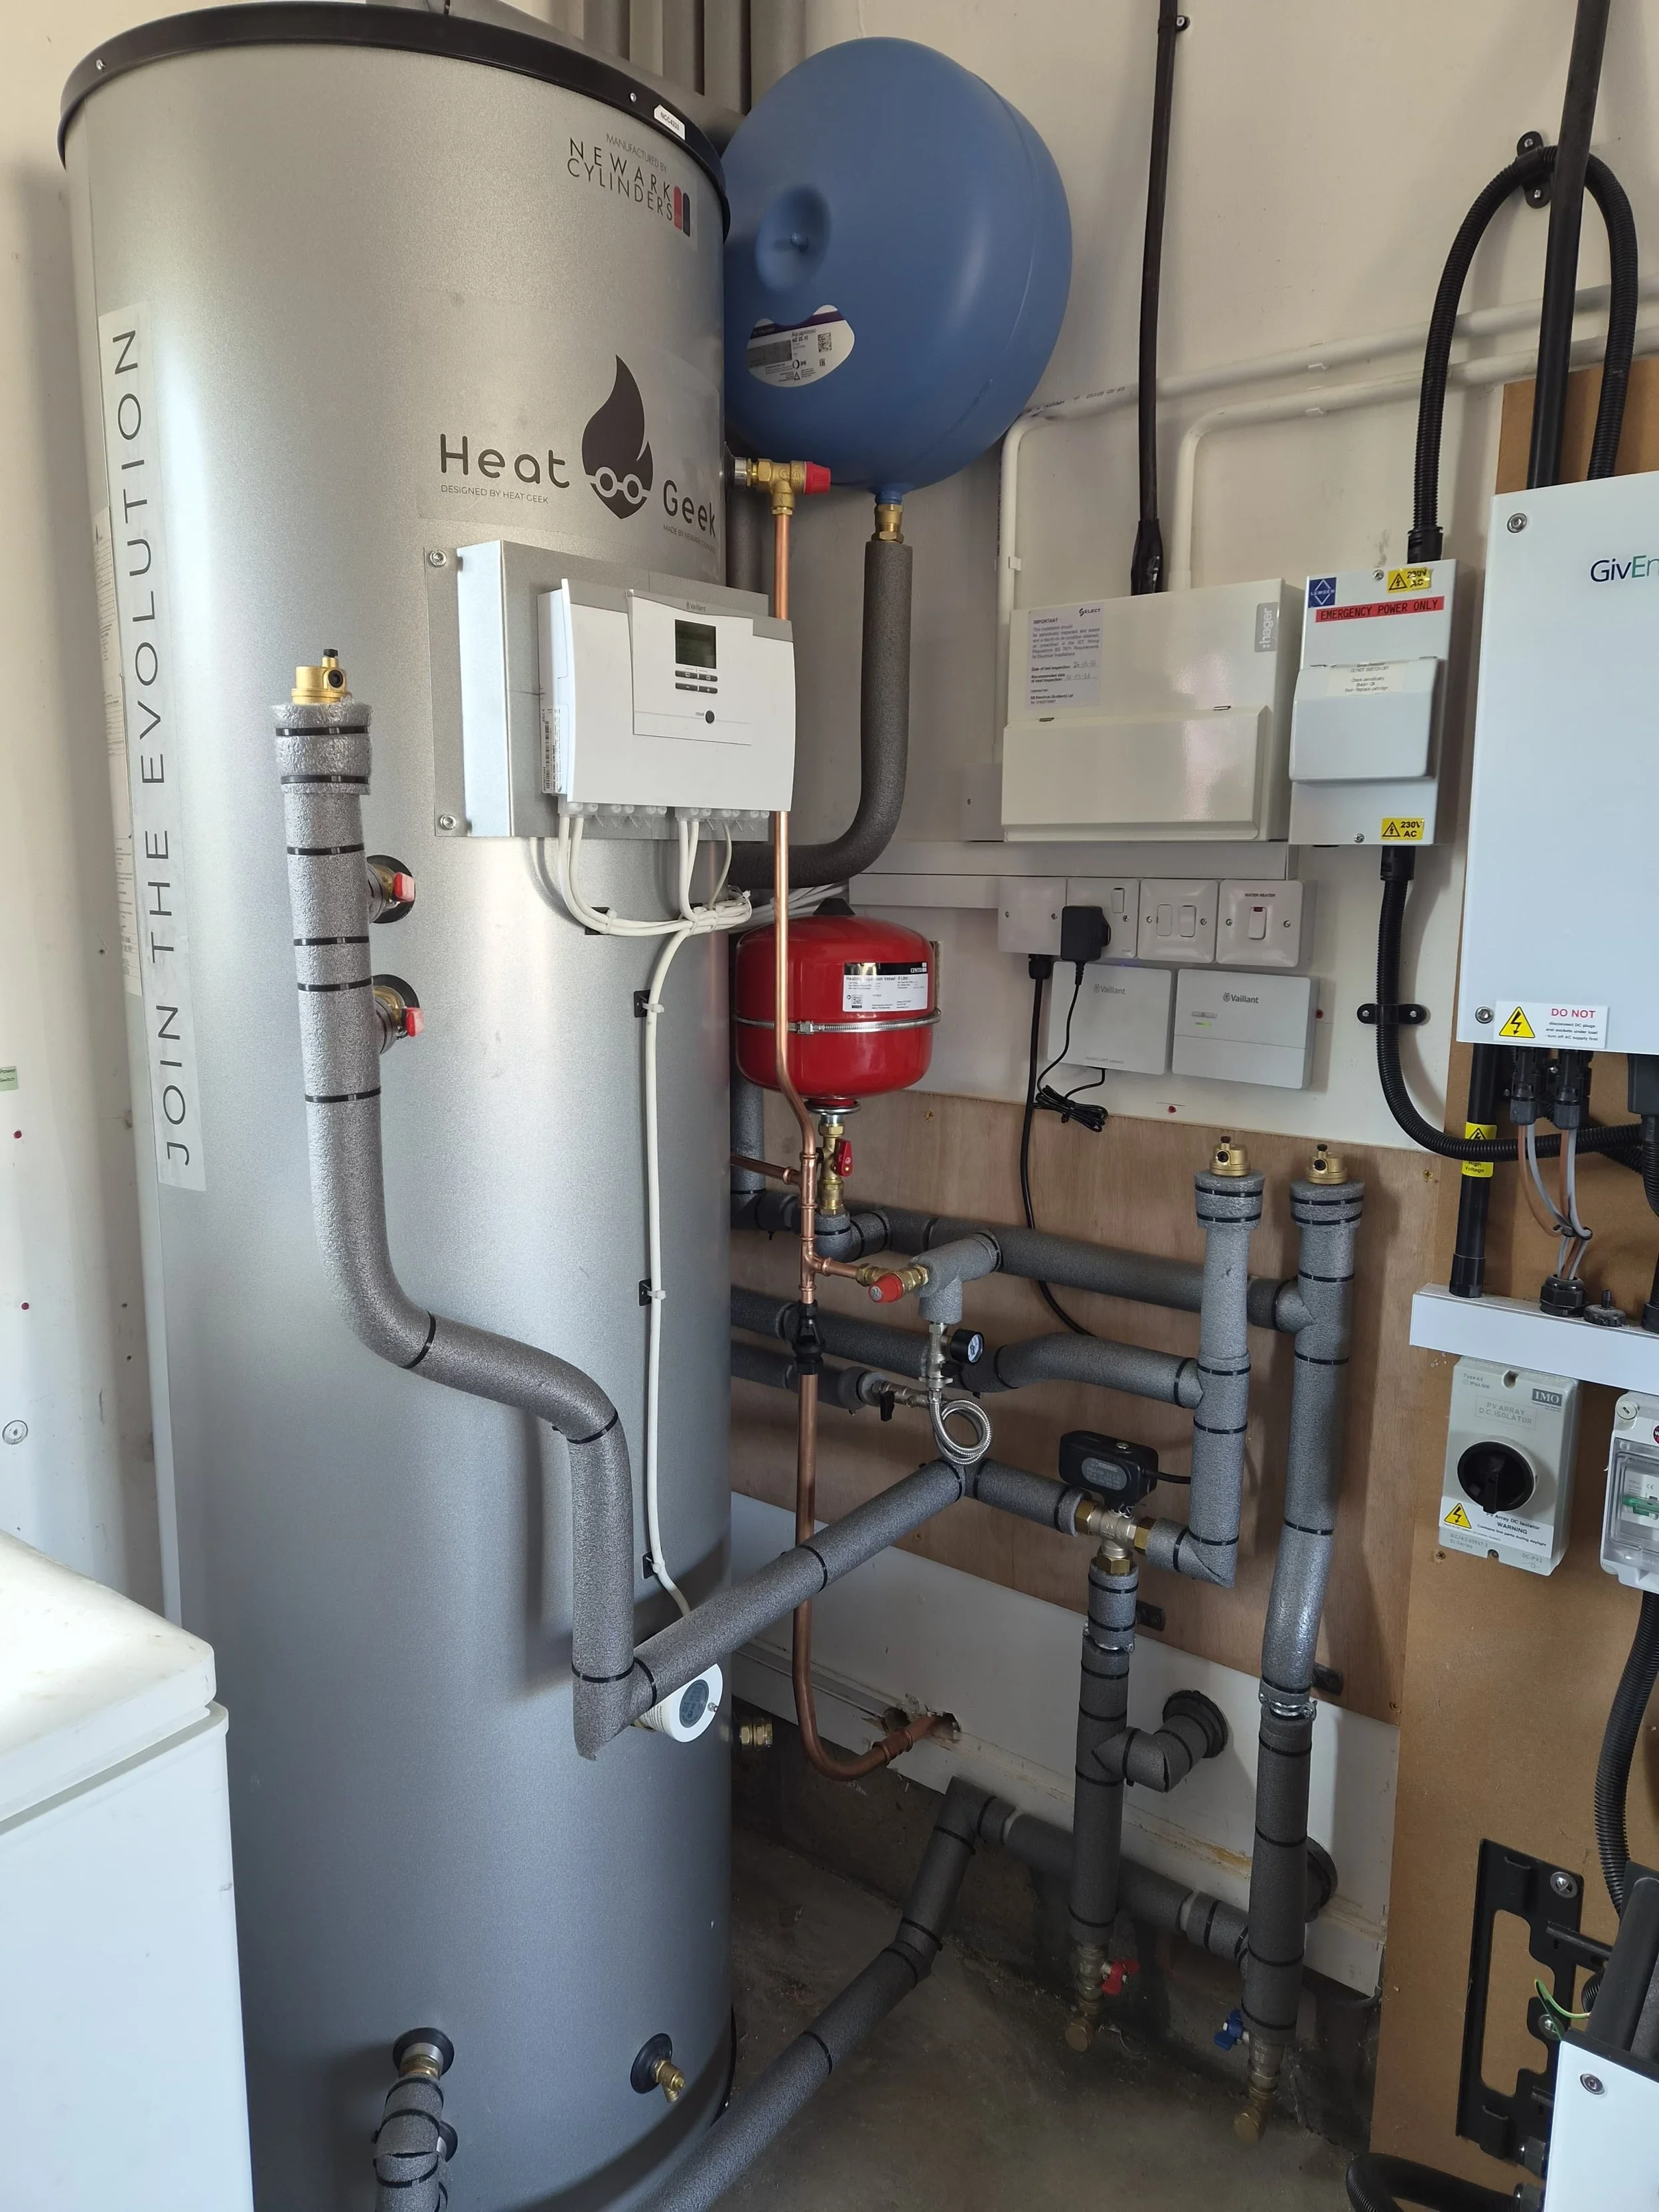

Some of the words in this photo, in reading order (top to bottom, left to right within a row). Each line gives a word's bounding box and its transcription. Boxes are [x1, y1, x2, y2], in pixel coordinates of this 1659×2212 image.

[606, 133, 659, 169] MANUFACTURED
[660, 161, 668, 173] BY
[570, 137, 670, 202] NEWARK
[567, 158, 673, 221] CYLINDERS
[440, 433, 570, 488] Heat
[663, 479, 716, 539] Geek
[441, 484, 487, 496] DESIGNED
[490, 488, 500, 497] BY
[503, 490, 525, 500] HEAT
[526, 494, 549, 504] GEEK
[112, 330, 165, 784] EVOLUTION
[1321, 607, 1372, 621] EMERGENCY
[1378, 603, 1408, 615] POWER
[1413, 599, 1438, 611] ONLY
[145, 830, 174, 964] THE
[1101, 985, 1126, 995] Vaillant
[1231, 994, 1260, 1003] Vaillant
[1551, 1008, 1568, 1017] DO
[1571, 1009, 1596, 1019] NOT
[156, 1005, 189, 1166] JOIN
[1465, 1165, 1484, 1173] Voltage
[1535, 1390, 1559, 1404] IMO
[1494, 1410, 1532, 1424] ISOLATOR
[1498, 1405, 1526, 1416] ARRAY
[1495, 1514, 1509, 1522] Array
[1520, 1520, 1540, 1530] Isolator
[1497, 1521, 1528, 1534] WARNING
[1516, 1534, 1530, 1543] during
[1530, 1538, 1547, 1547] daylight
